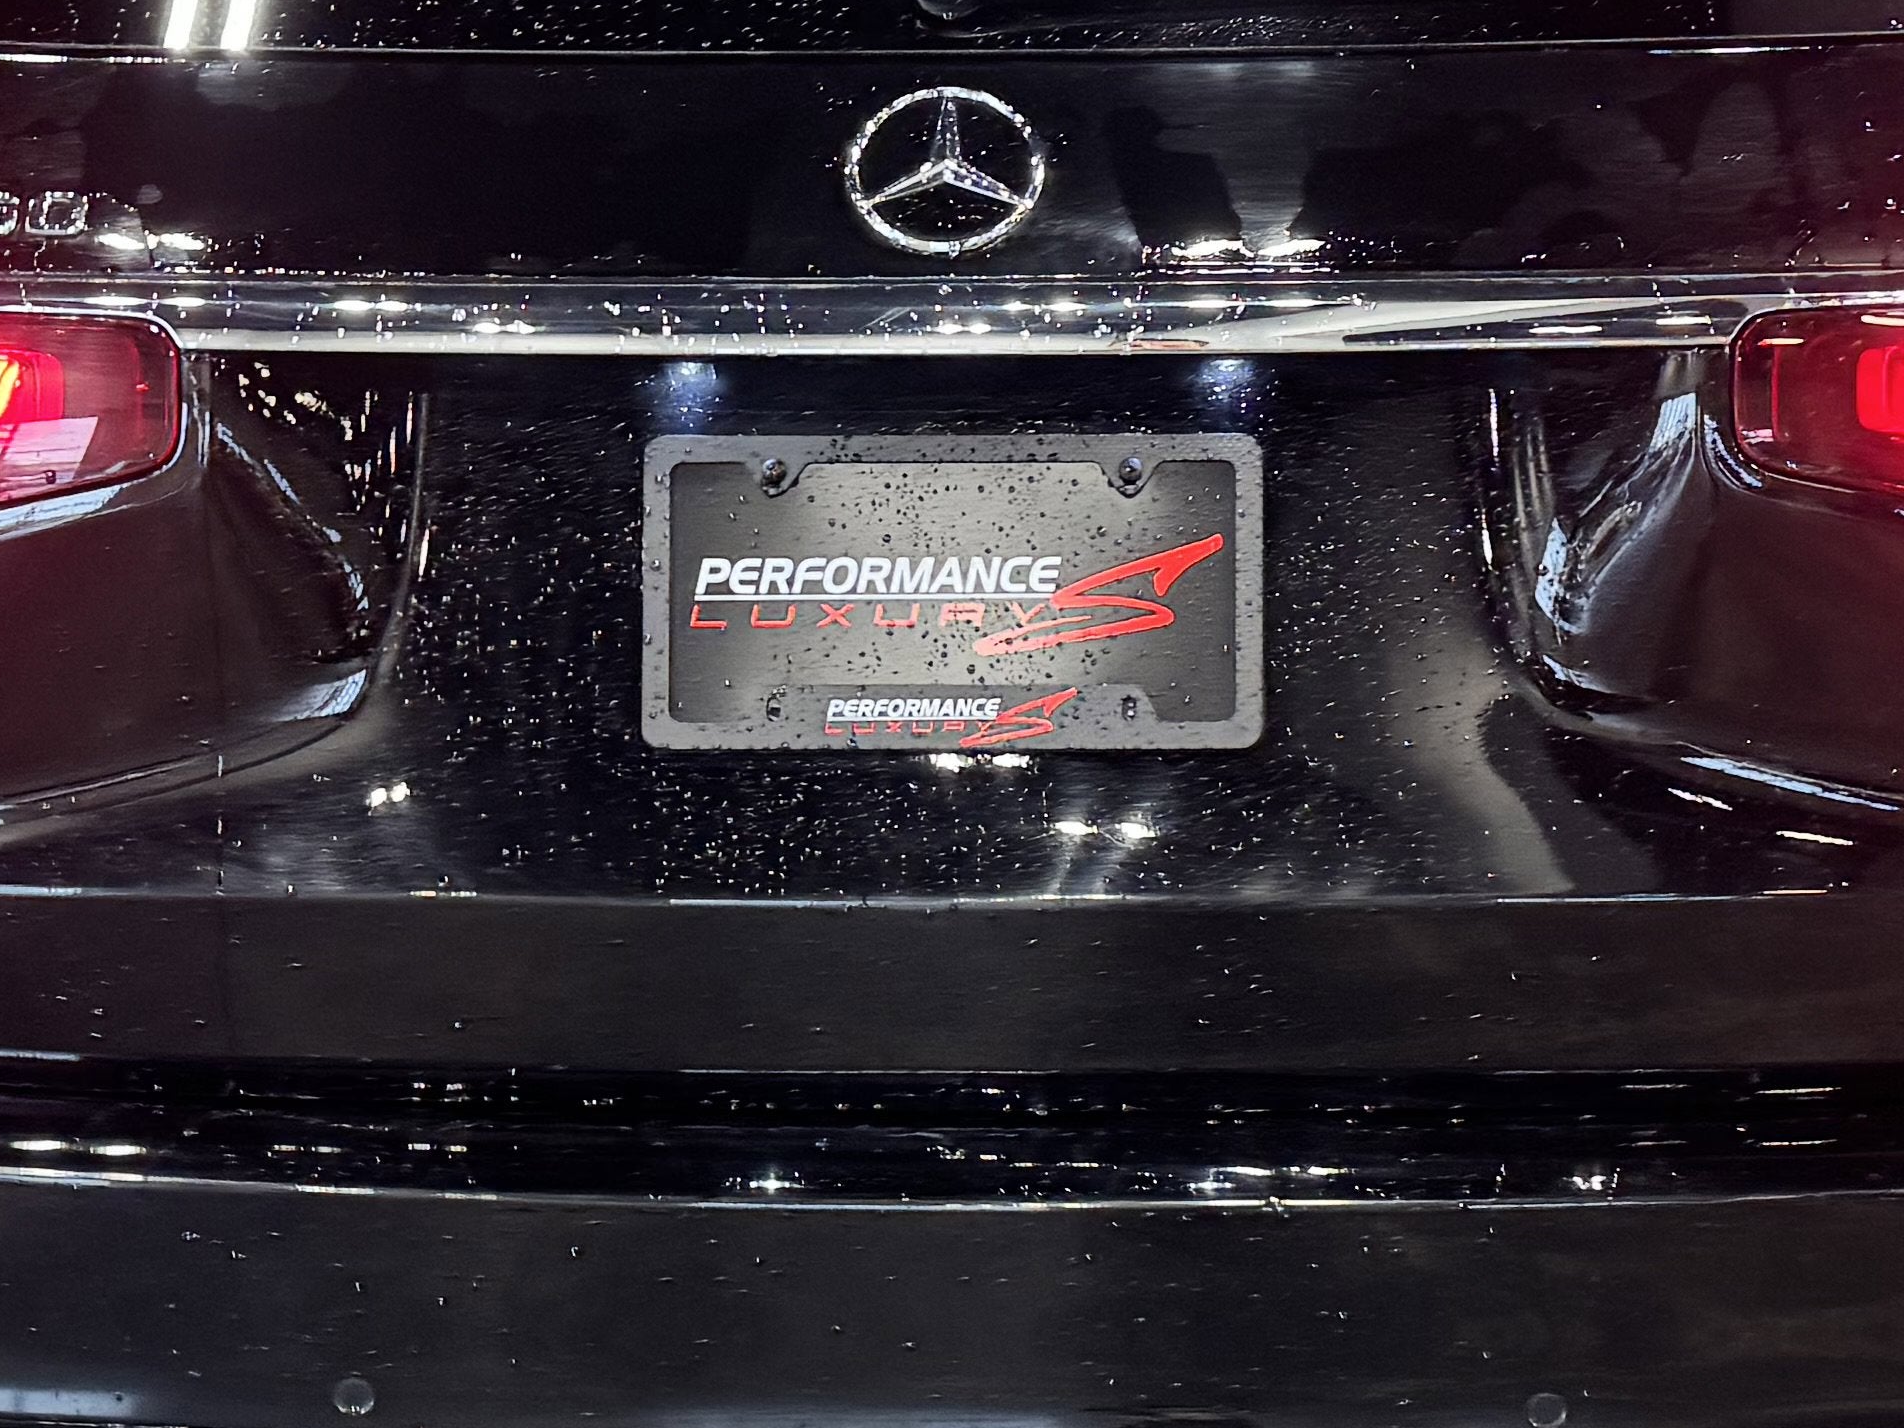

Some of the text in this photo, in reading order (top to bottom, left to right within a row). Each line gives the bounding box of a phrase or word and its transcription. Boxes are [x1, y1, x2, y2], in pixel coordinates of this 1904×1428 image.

[695, 556, 1062, 594] PERFORMANCE
[690, 602, 1047, 628] LUXURY
[827, 698, 1001, 719] PERFORMANCE
